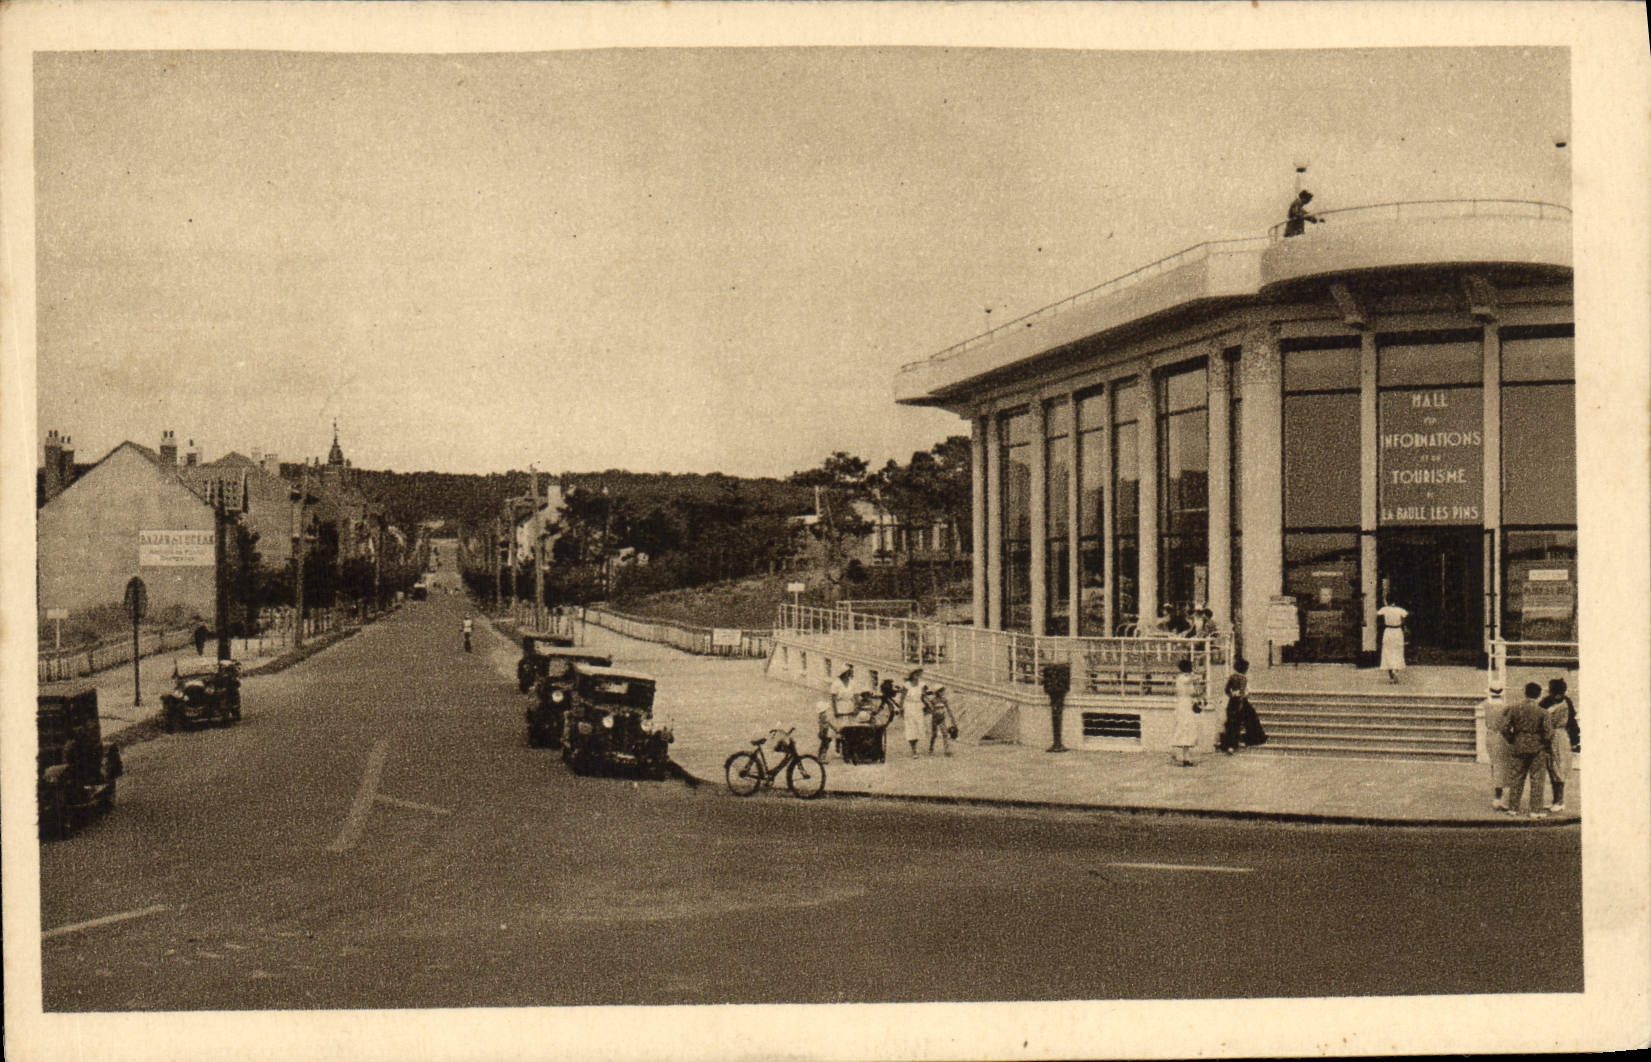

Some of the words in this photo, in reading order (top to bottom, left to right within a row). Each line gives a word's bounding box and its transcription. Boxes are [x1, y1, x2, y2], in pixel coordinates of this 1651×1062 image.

[1412, 392, 1448, 408] HALL
[1380, 432, 1481, 448] INFORMATIONS
[1391, 468, 1467, 484] TOURISME
[1382, 508, 1394, 520] LA
[1396, 506, 1426, 520] BAULE
[1430, 506, 1449, 520] LES
[1452, 505, 1480, 520] PINS
